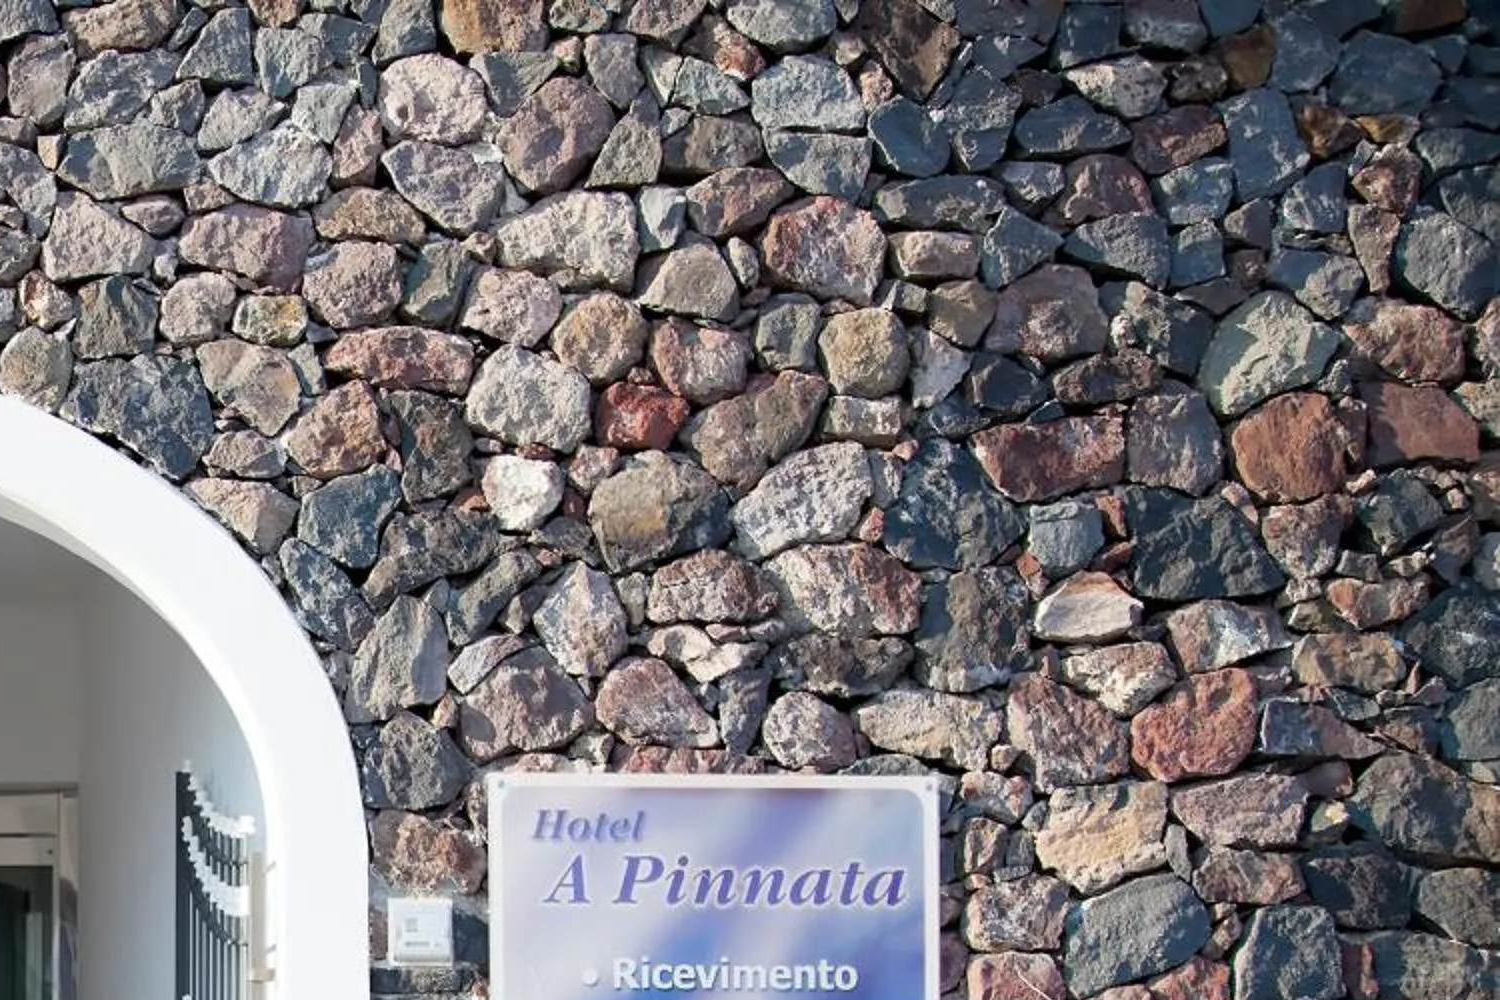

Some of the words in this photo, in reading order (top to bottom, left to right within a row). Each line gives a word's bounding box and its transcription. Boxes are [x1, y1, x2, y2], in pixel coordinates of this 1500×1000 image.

[531, 808, 647, 843] Hotel
[544, 852, 591, 905] A
[611, 853, 907, 908] Pinnata
[611, 956, 859, 993] Ricevimento
